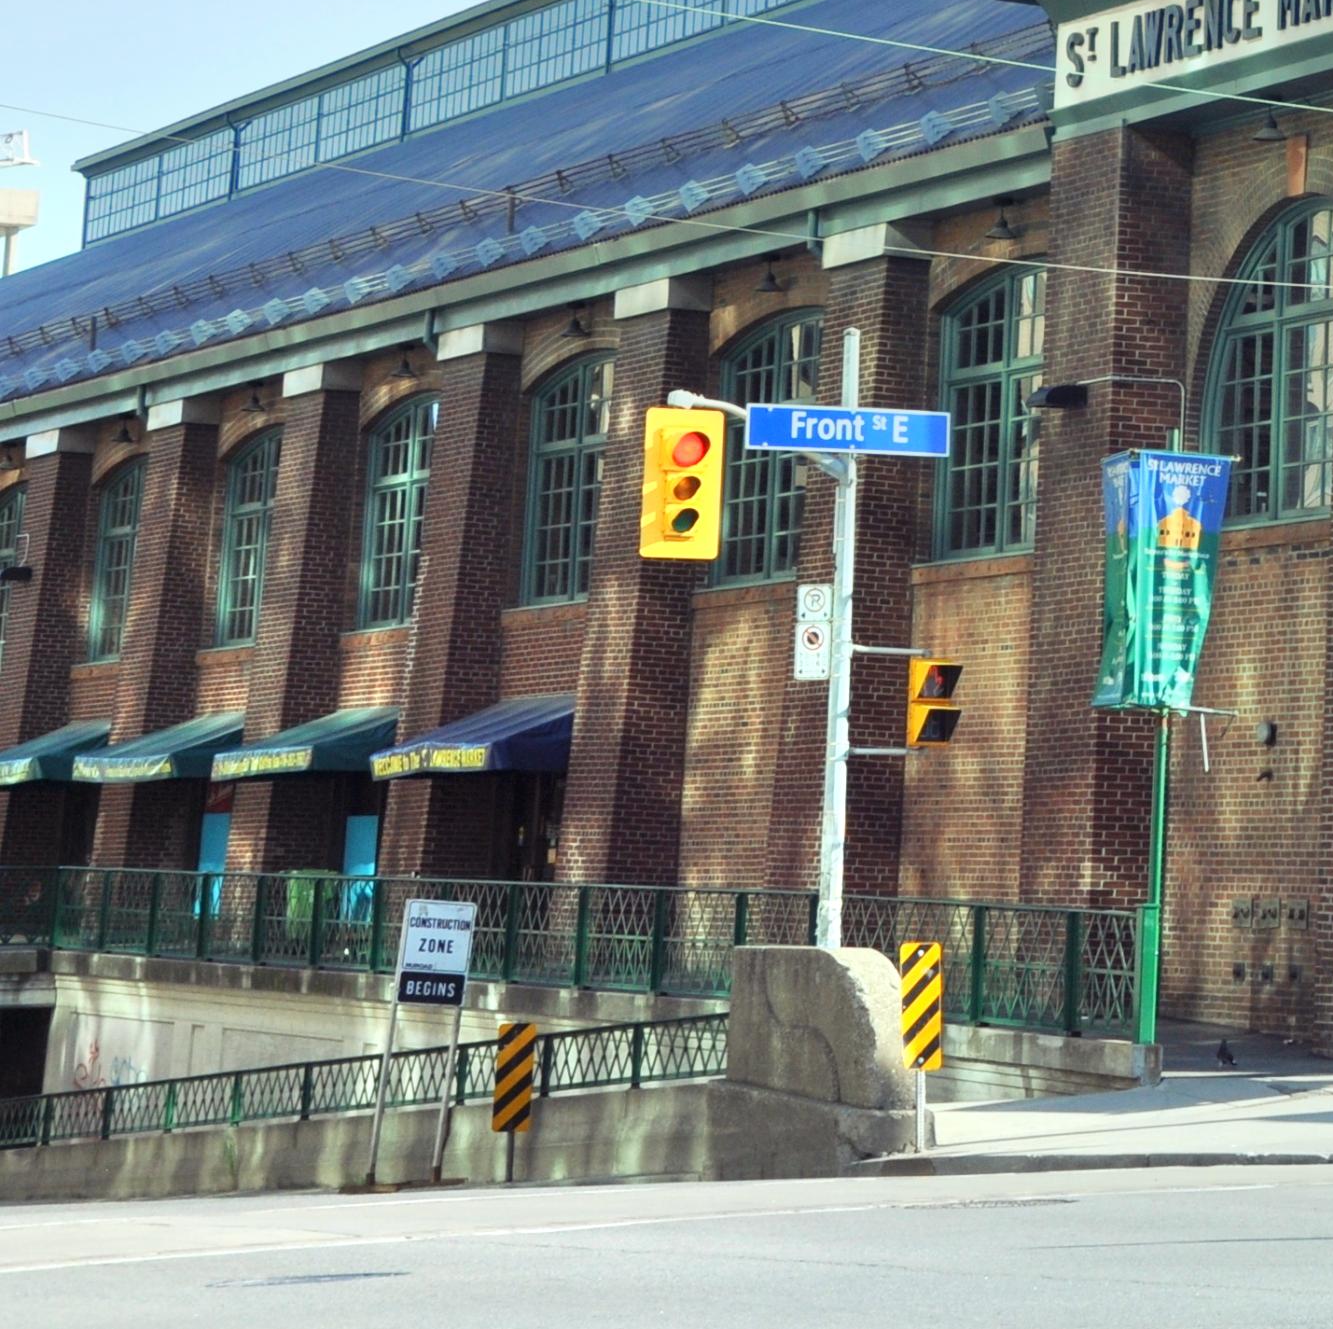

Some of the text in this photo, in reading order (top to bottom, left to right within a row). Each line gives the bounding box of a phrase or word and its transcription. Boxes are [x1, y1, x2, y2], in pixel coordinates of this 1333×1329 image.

[791, 411, 909, 444] Front St E
[1160, 460, 1222, 477] LAWRENCE
[1158, 472, 1207, 487] MARKET
[409, 916, 471, 931] CONSTRUCTION
[418, 938, 454, 954] ZONE
[405, 980, 456, 997] BEGINS
